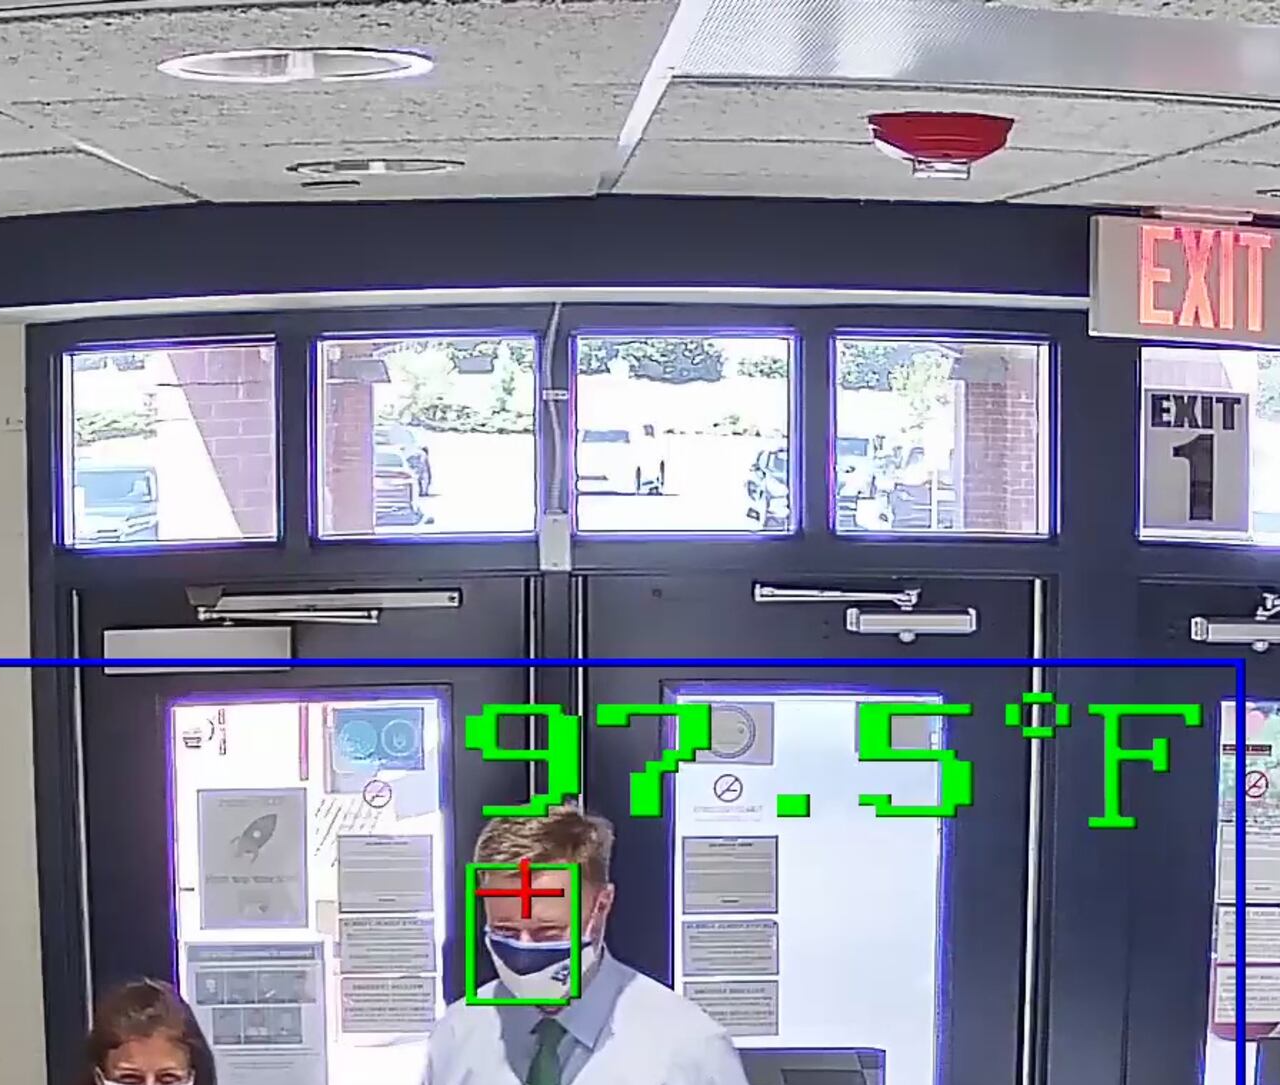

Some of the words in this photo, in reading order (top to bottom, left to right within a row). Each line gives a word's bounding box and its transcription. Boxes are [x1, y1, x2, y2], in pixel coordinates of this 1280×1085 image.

[1139, 225, 1273, 332] EXIT
[1150, 393, 1242, 430] EXIT
[1172, 433, 1215, 521] 1
